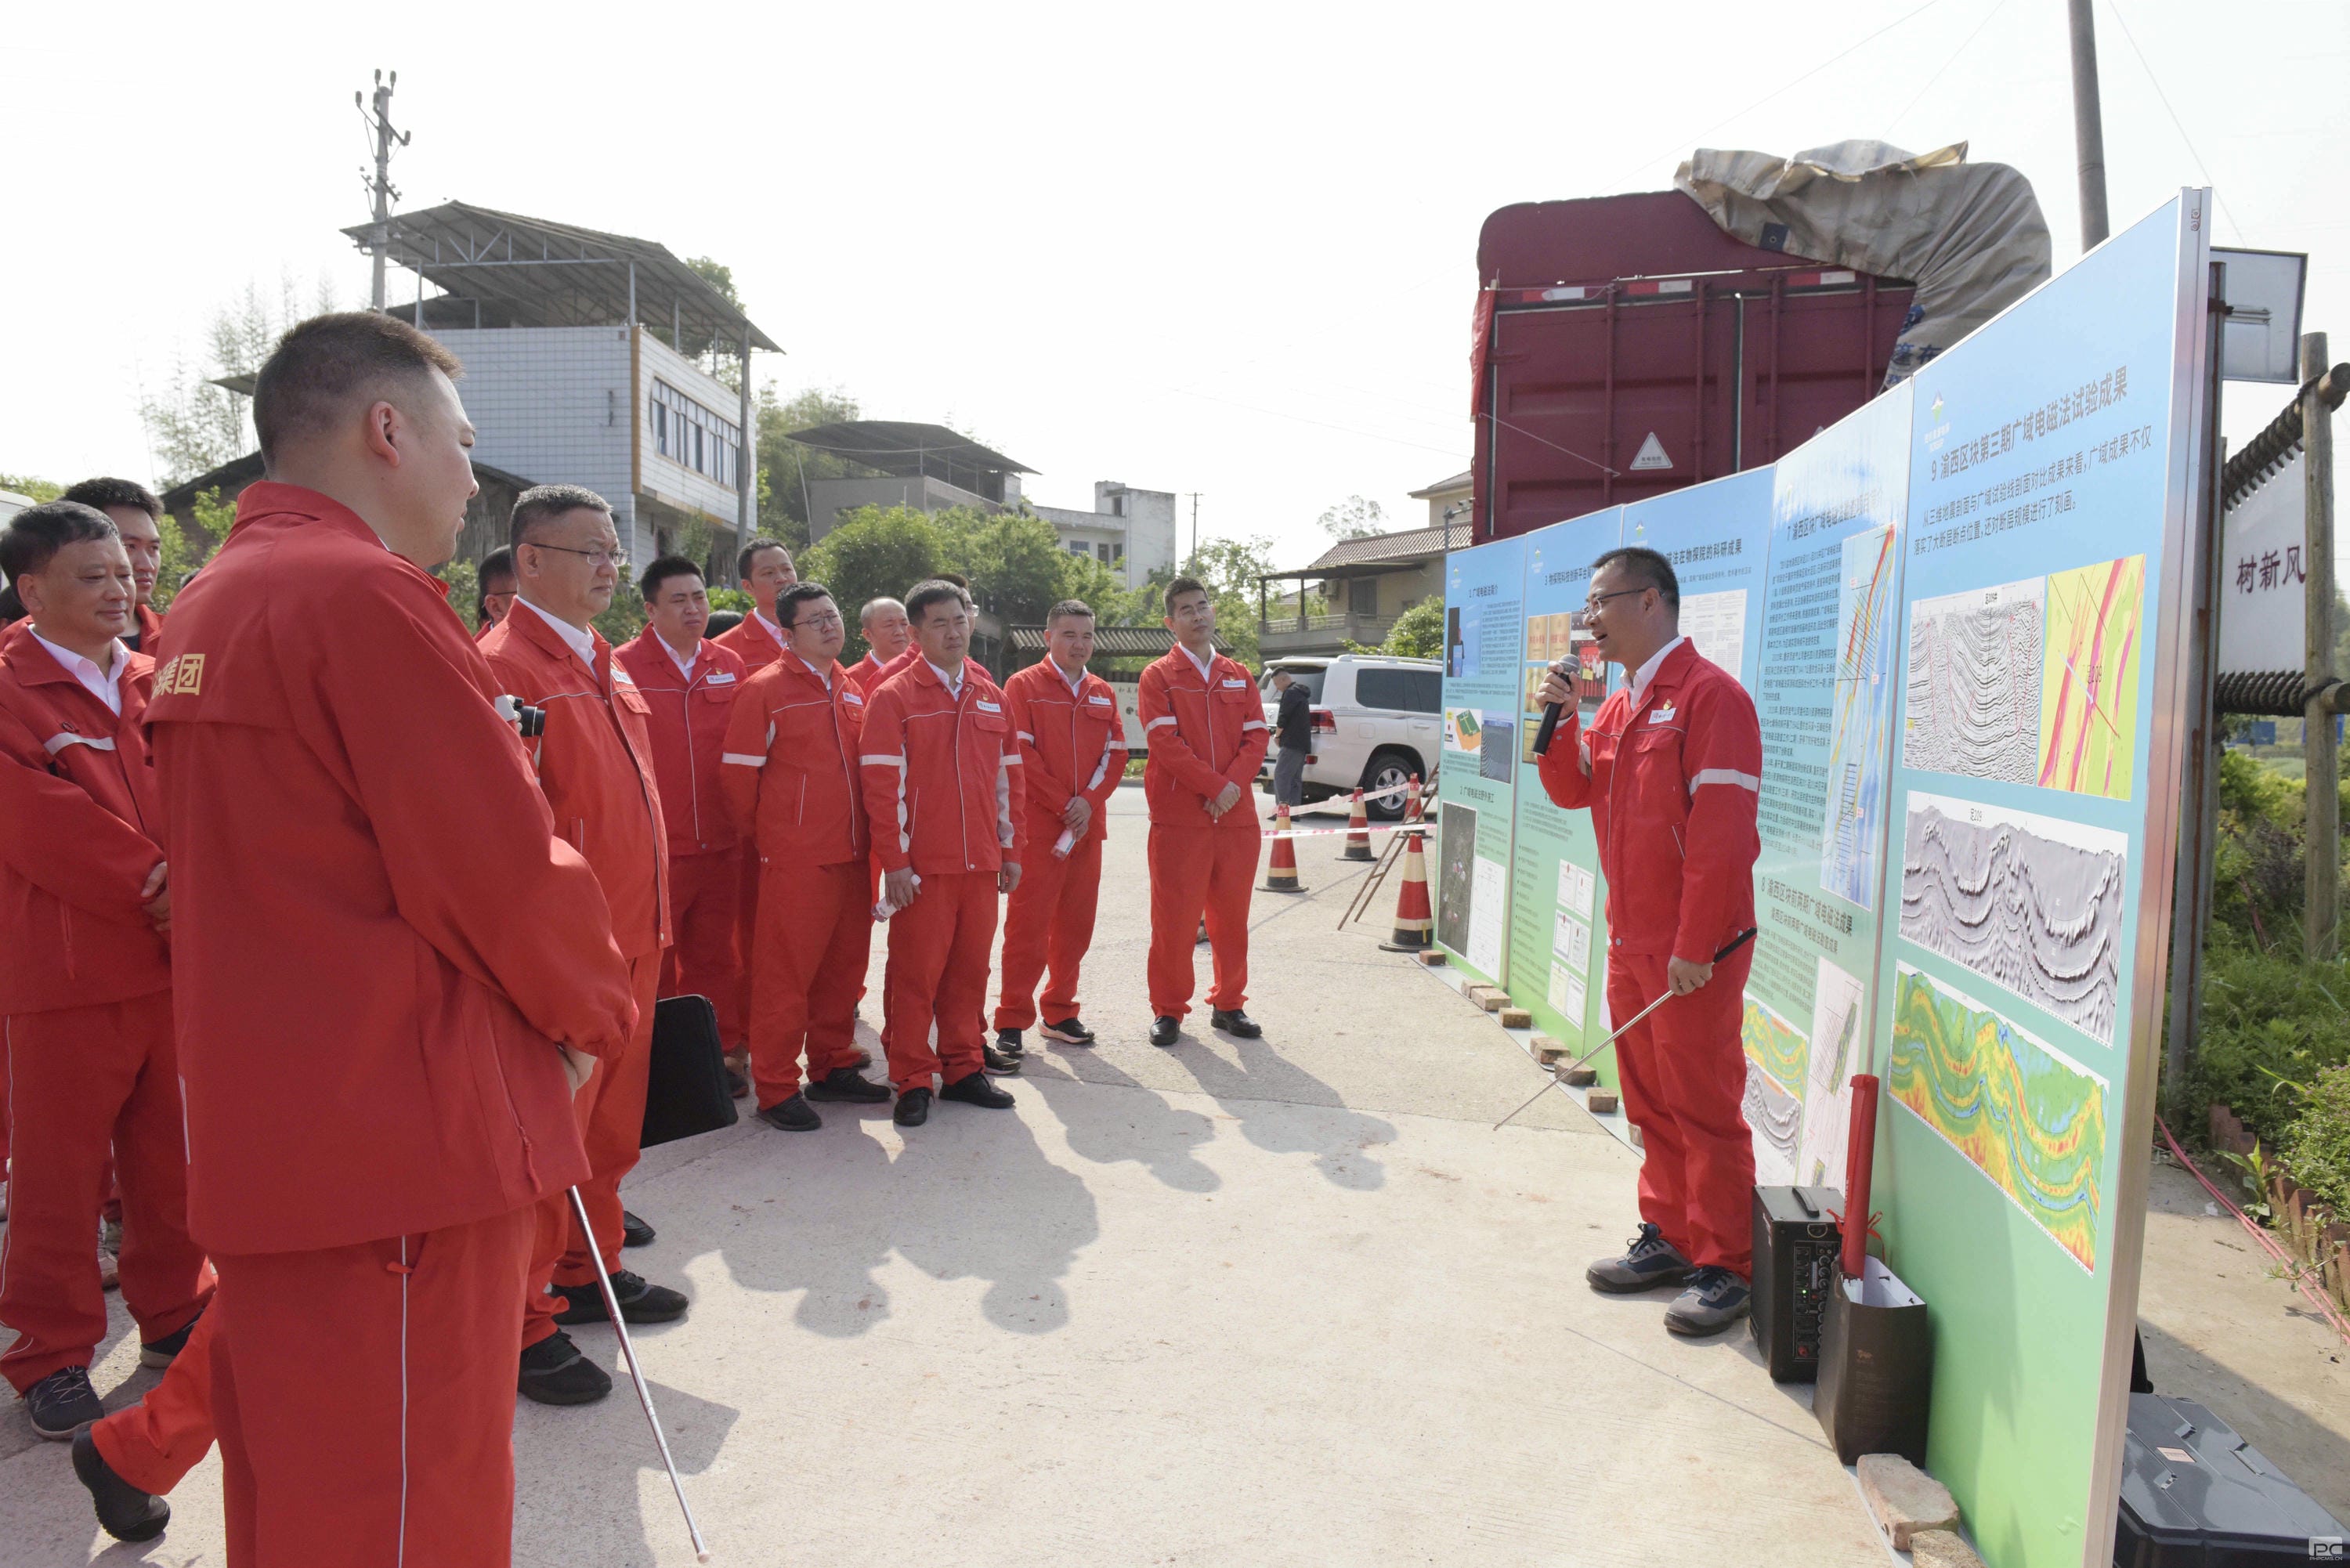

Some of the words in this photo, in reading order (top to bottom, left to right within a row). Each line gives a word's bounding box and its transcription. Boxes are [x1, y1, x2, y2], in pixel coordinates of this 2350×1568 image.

[1931, 460, 1937, 482] 9
[1940, 365, 2128, 480] 渝西区块第三期广域电磁法试验成果
[2236, 545, 2306, 594] 树新风
